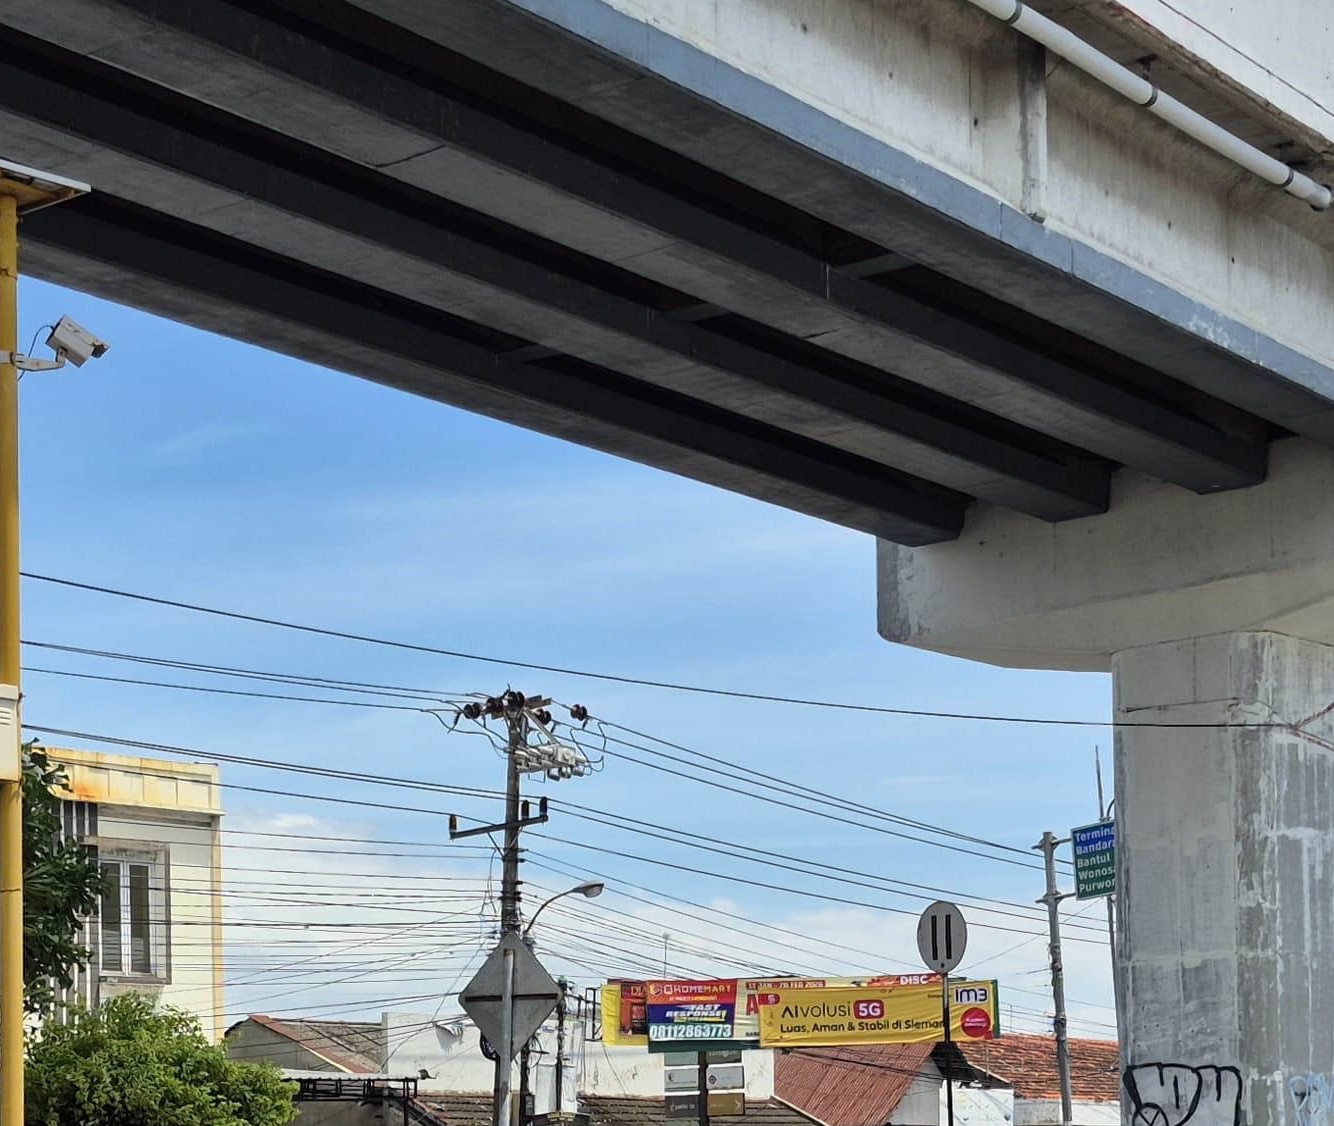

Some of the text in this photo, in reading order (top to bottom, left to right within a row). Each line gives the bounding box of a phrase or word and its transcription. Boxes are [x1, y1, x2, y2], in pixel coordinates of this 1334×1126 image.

[1077, 852, 1111, 869] Bantul
[857, 1001, 882, 1016] 5G
[649, 1024, 732, 1039] 08112863773
[811, 1020, 845, 1032] Aman
[847, 1021, 856, 1031] &
[857, 1018, 890, 1031] Stabil
[892, 1018, 903, 1030] di
